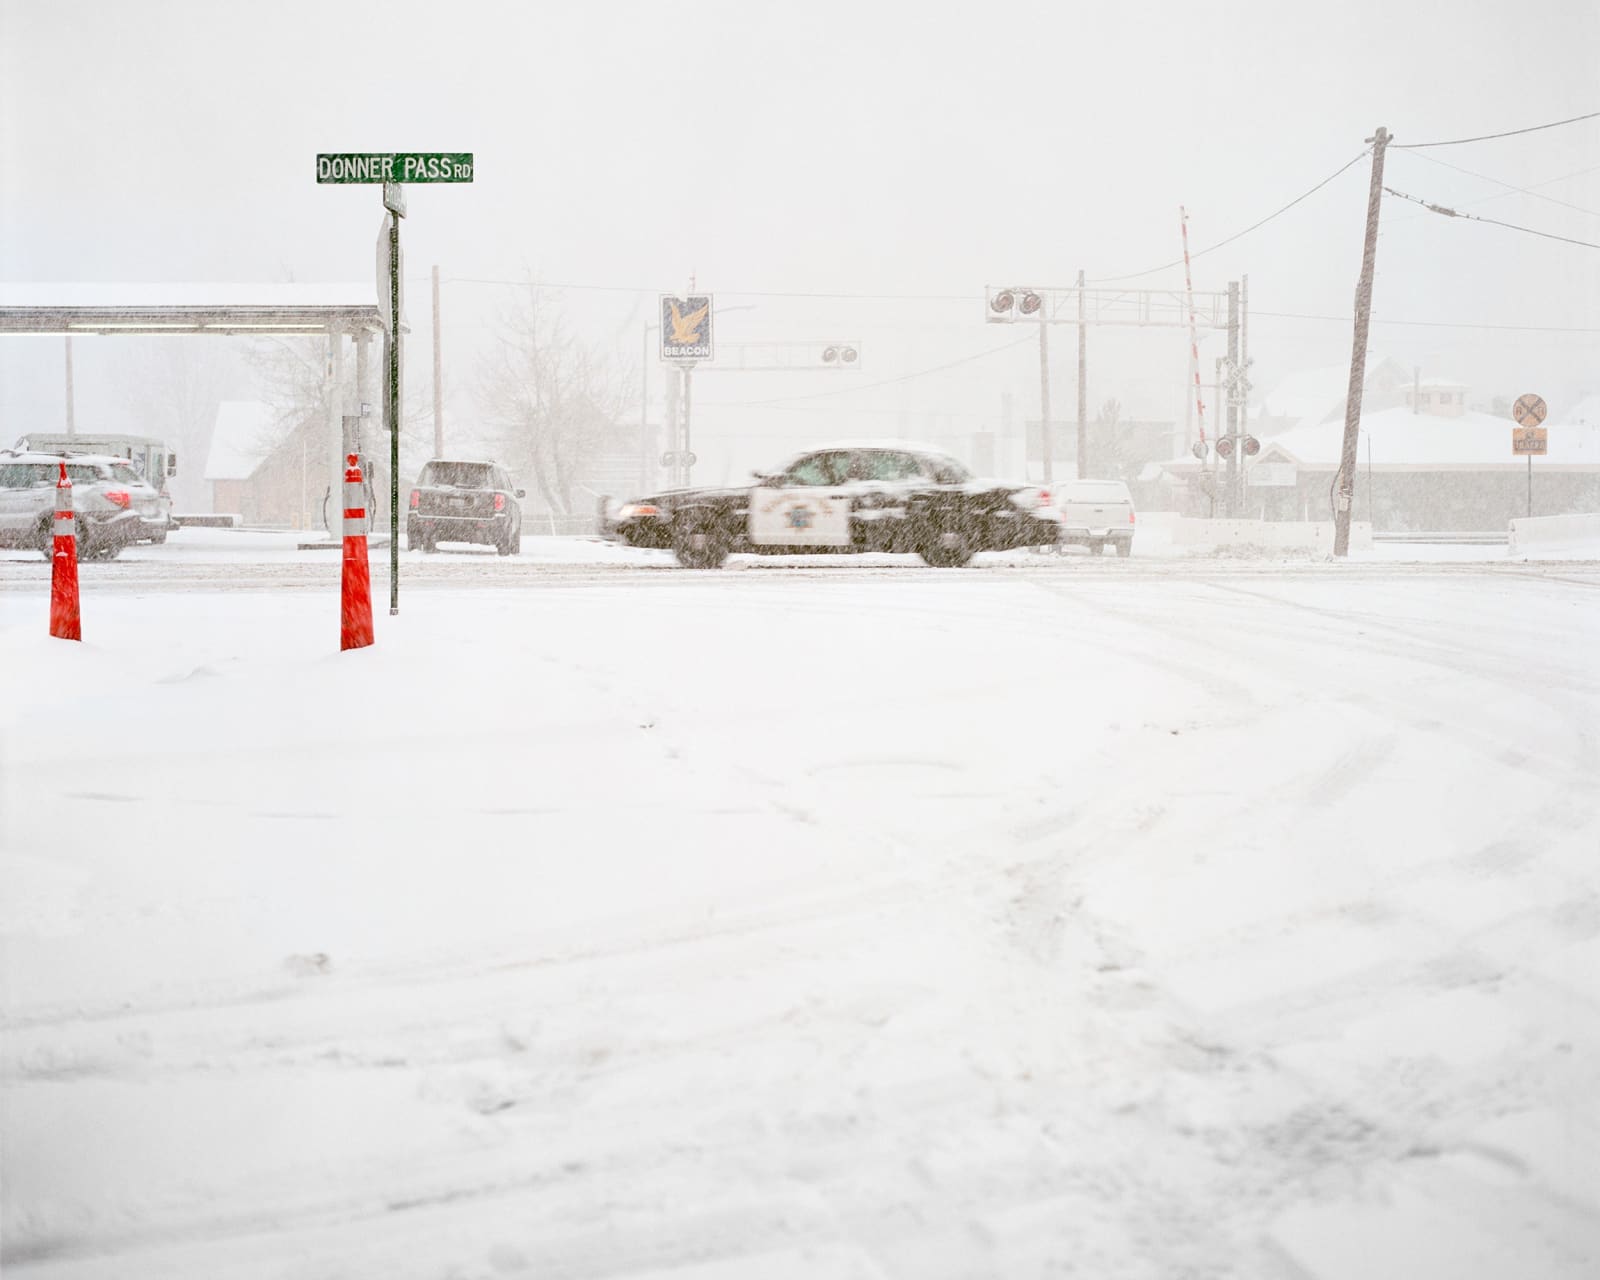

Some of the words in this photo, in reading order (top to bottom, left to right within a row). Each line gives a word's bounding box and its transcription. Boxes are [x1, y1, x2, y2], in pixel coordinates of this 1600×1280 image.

[319, 157, 394, 179] DONNER
[404, 157, 452, 179] PASS
[454, 164, 471, 178] RD
[664, 346, 709, 356] BEACON
